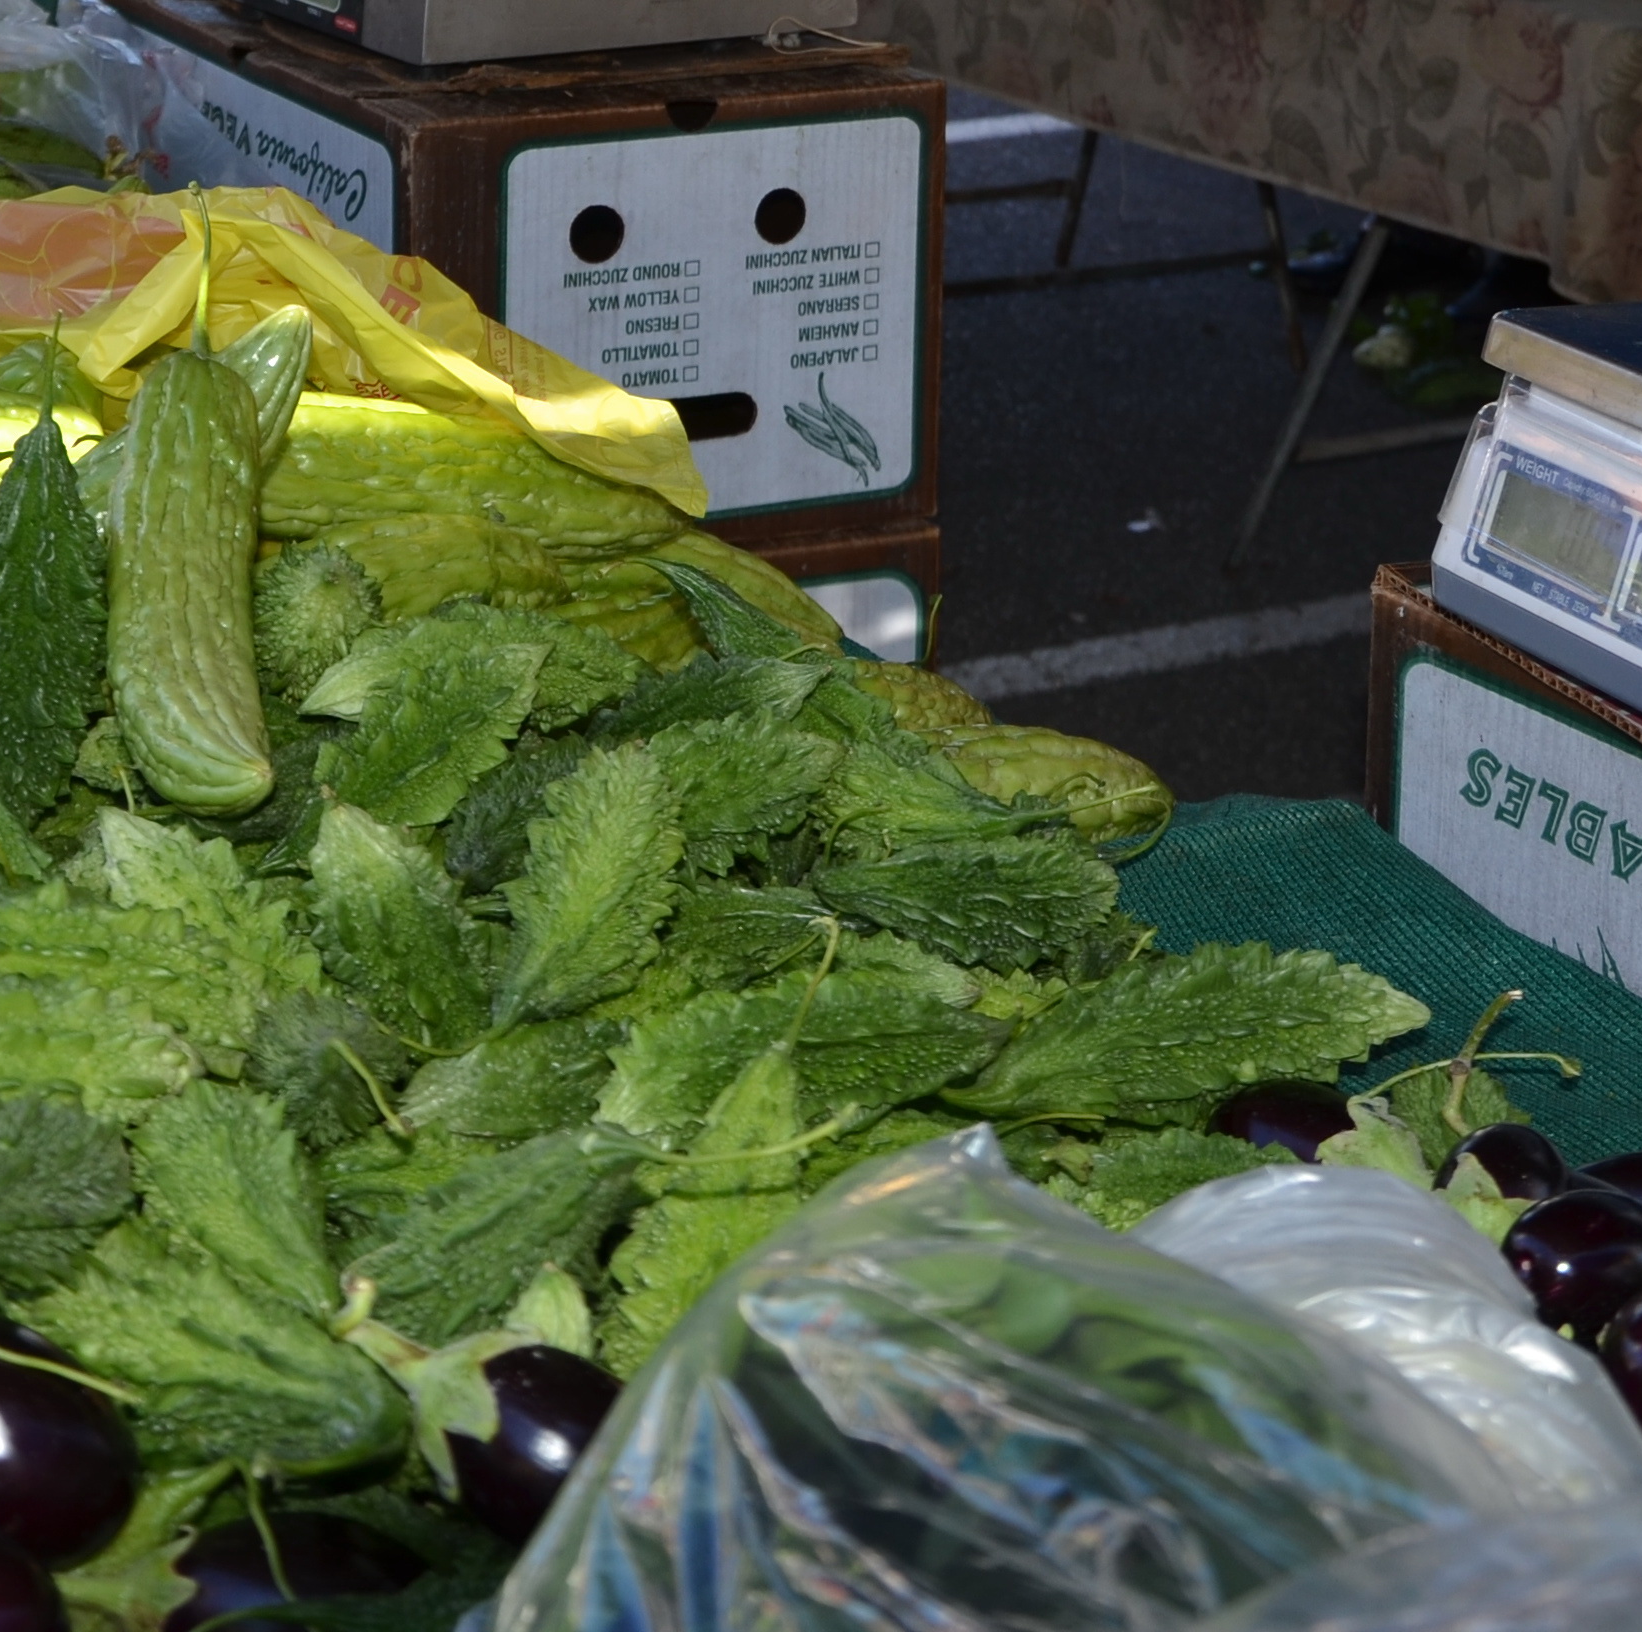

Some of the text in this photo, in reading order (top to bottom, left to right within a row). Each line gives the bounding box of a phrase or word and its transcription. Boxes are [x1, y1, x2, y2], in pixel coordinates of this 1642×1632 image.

[256, 130, 367, 221] California
[746, 244, 861, 269] ITALIAN ZUCCHINI
[564, 263, 680, 288] ROUND ZUCCHINI
[753, 270, 859, 295] WHITE ZUCCHINI
[588, 289, 679, 312] YELLOW WAX
[798, 296, 859, 315] SERRANO
[626, 316, 679, 334] FRESNO
[798, 321, 859, 341] ANAHEIM
[602, 342, 678, 363] TOMATILLO
[791, 347, 858, 369] JALAPENO
[622, 368, 678, 387] TOMATO
[1515, 456, 1559, 485] WEIGHT
